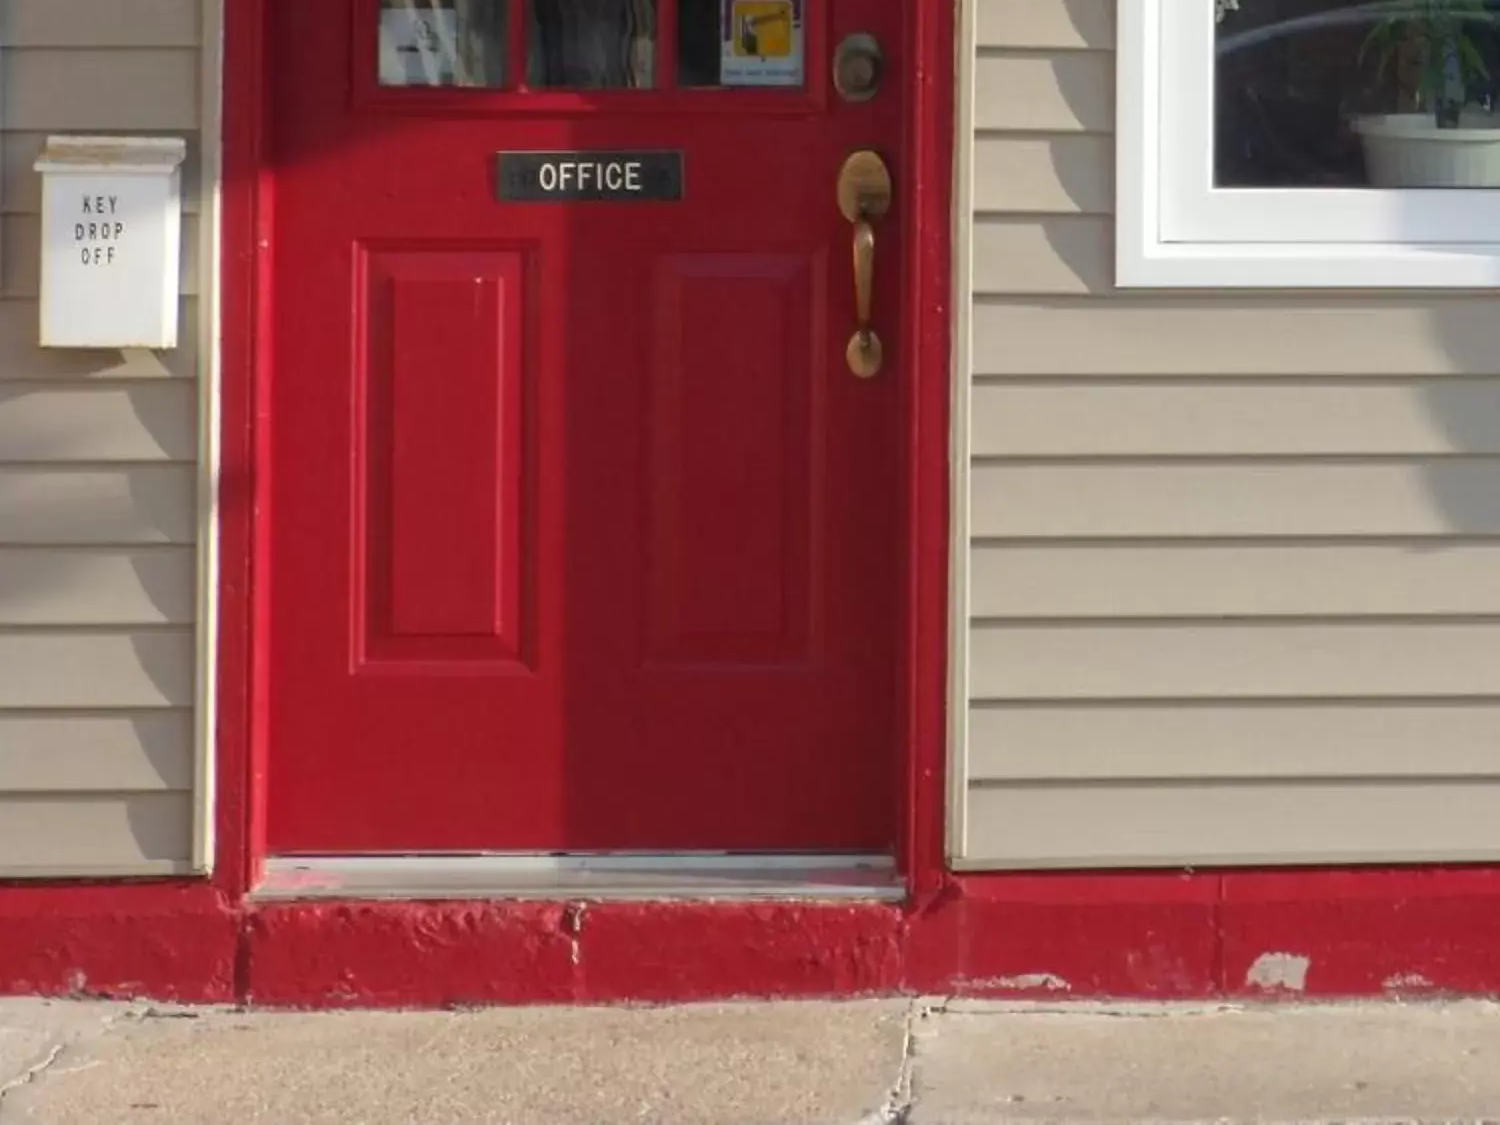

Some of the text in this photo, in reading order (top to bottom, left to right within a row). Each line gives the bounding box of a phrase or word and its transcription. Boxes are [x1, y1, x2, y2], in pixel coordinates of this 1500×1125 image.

[538, 162, 643, 191] OFFICE
[81, 194, 119, 215] KEY
[74, 222, 124, 241] DROP
[80, 247, 117, 266] OFF
